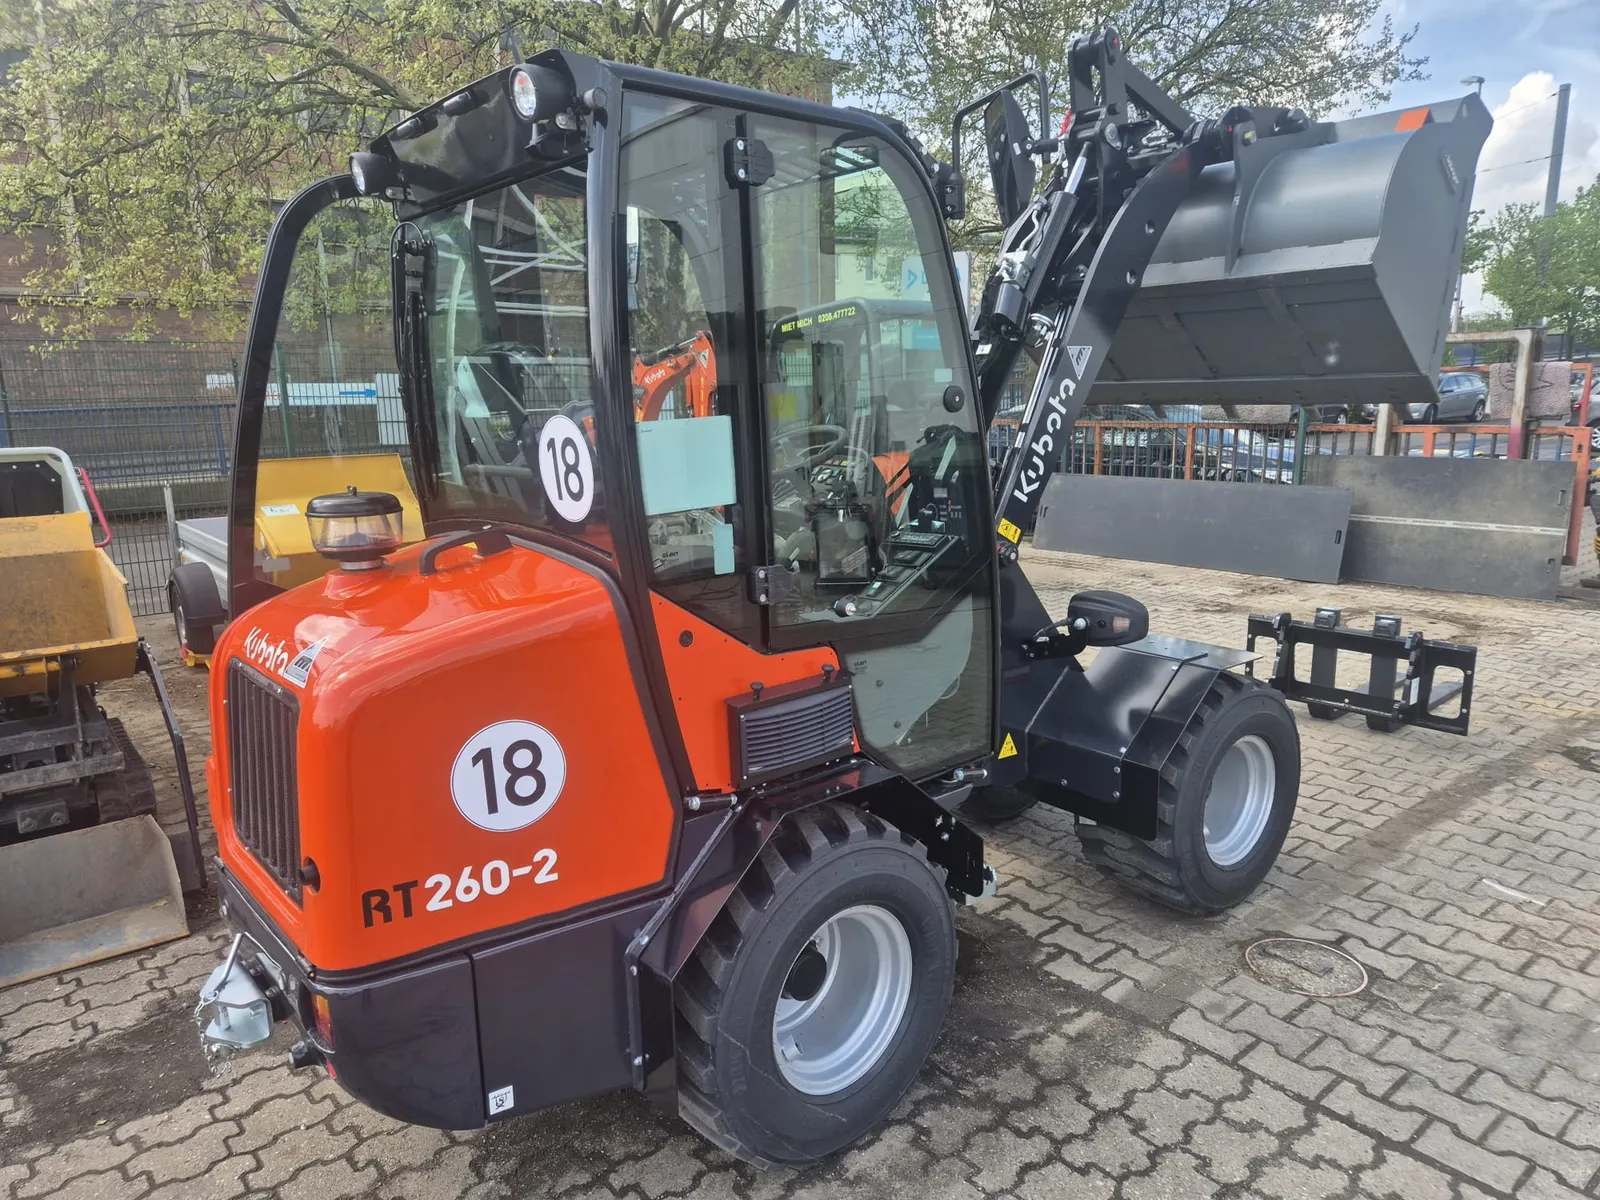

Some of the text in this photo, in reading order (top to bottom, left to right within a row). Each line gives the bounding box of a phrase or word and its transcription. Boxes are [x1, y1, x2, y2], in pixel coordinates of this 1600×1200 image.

[781, 321, 796, 333] MIET
[796, 317, 813, 329] MICH
[546, 436, 585, 503] 18
[1013, 377, 1077, 503] Kubota
[243, 625, 290, 678] Kubota
[471, 738, 547, 816] 18
